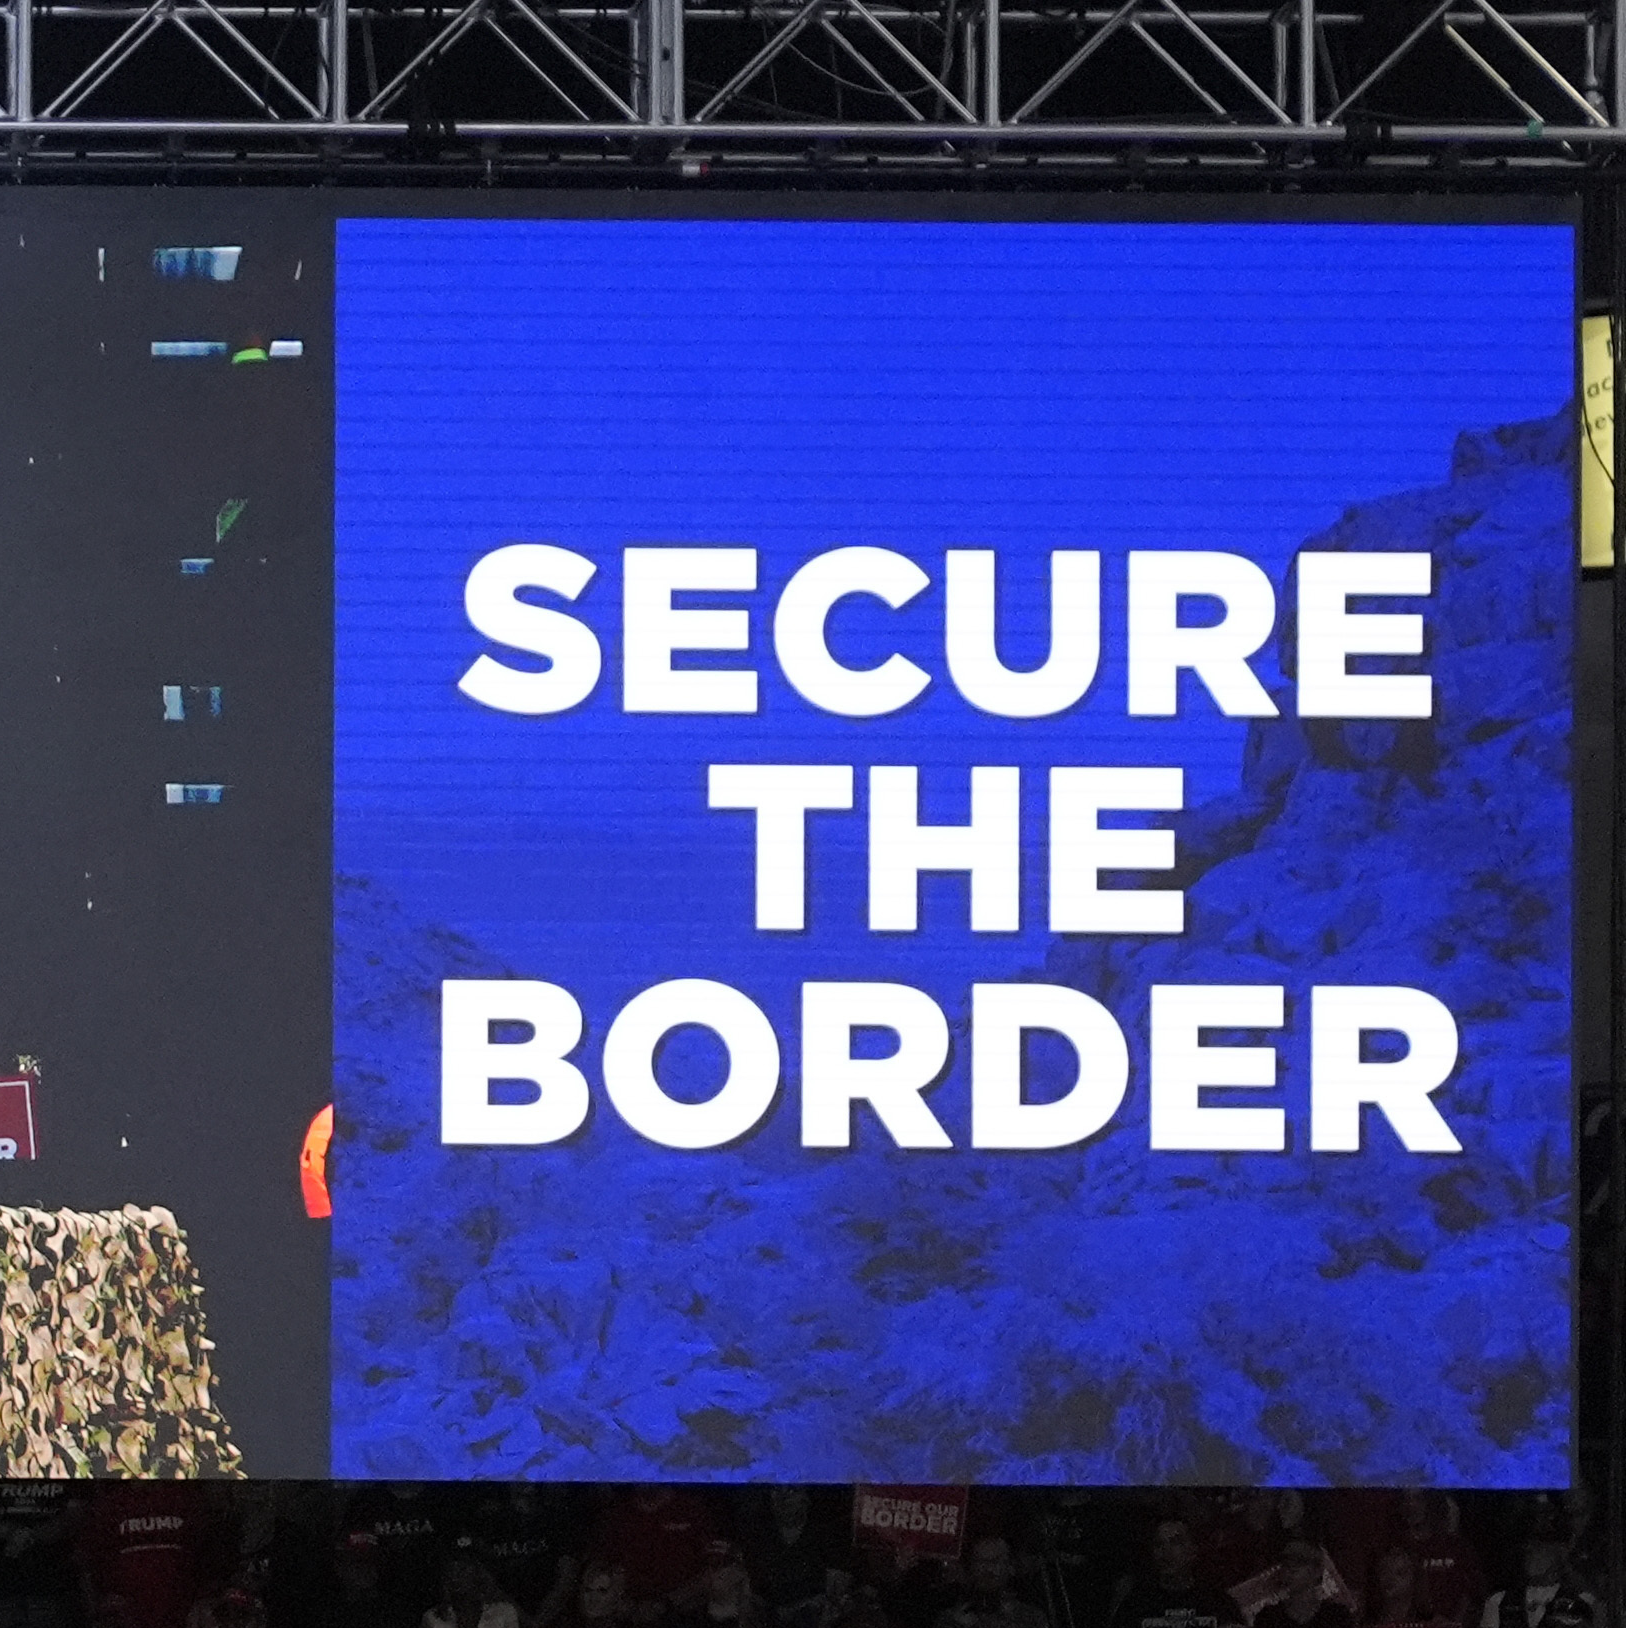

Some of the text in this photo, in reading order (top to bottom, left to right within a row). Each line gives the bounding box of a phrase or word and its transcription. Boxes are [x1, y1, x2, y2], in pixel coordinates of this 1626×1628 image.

[458, 544, 1431, 717] SECURE
[708, 765, 1184, 932] THE
[441, 978, 1462, 1152] BORDER
[862, 1506, 958, 1536] BORDER
